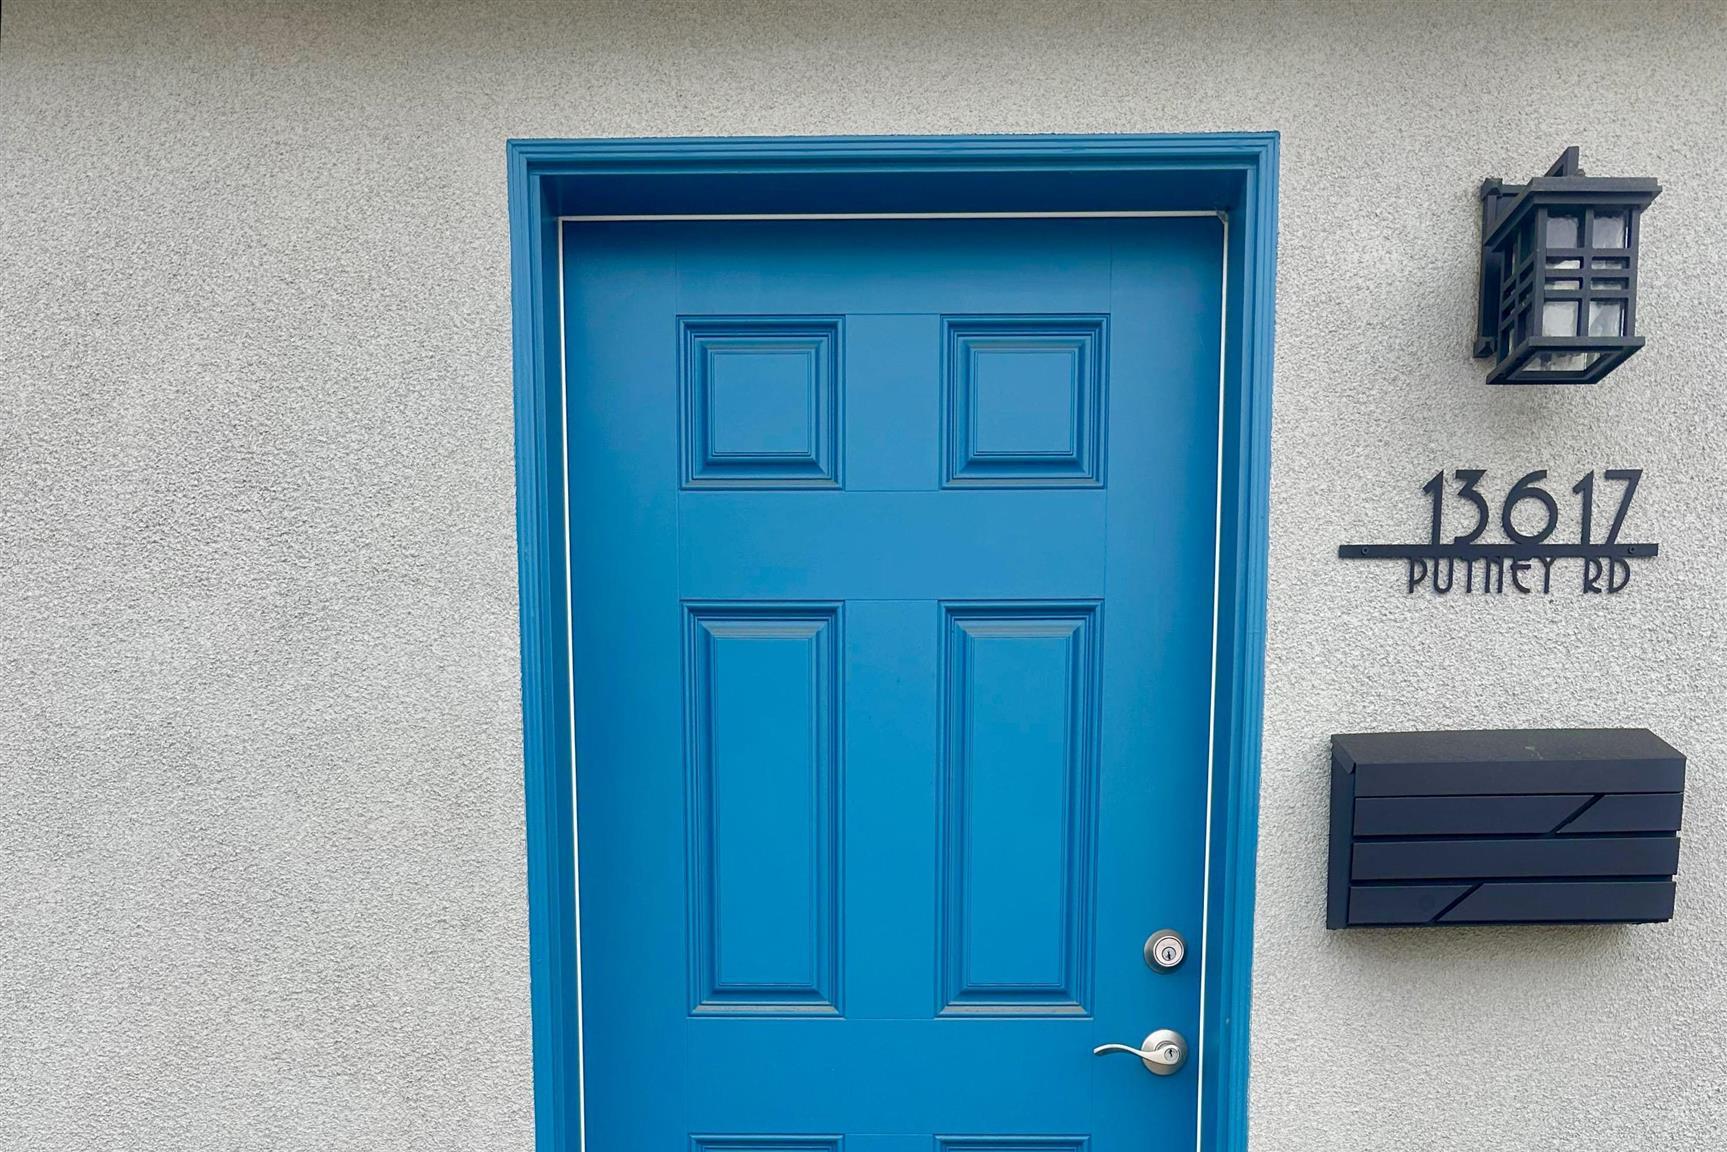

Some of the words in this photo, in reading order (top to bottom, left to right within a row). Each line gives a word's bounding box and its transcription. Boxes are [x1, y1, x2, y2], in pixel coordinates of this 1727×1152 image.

[1422, 469, 1643, 545] 13617
[1408, 556, 1555, 594] PUTNEY
[1583, 556, 1631, 594] RD
